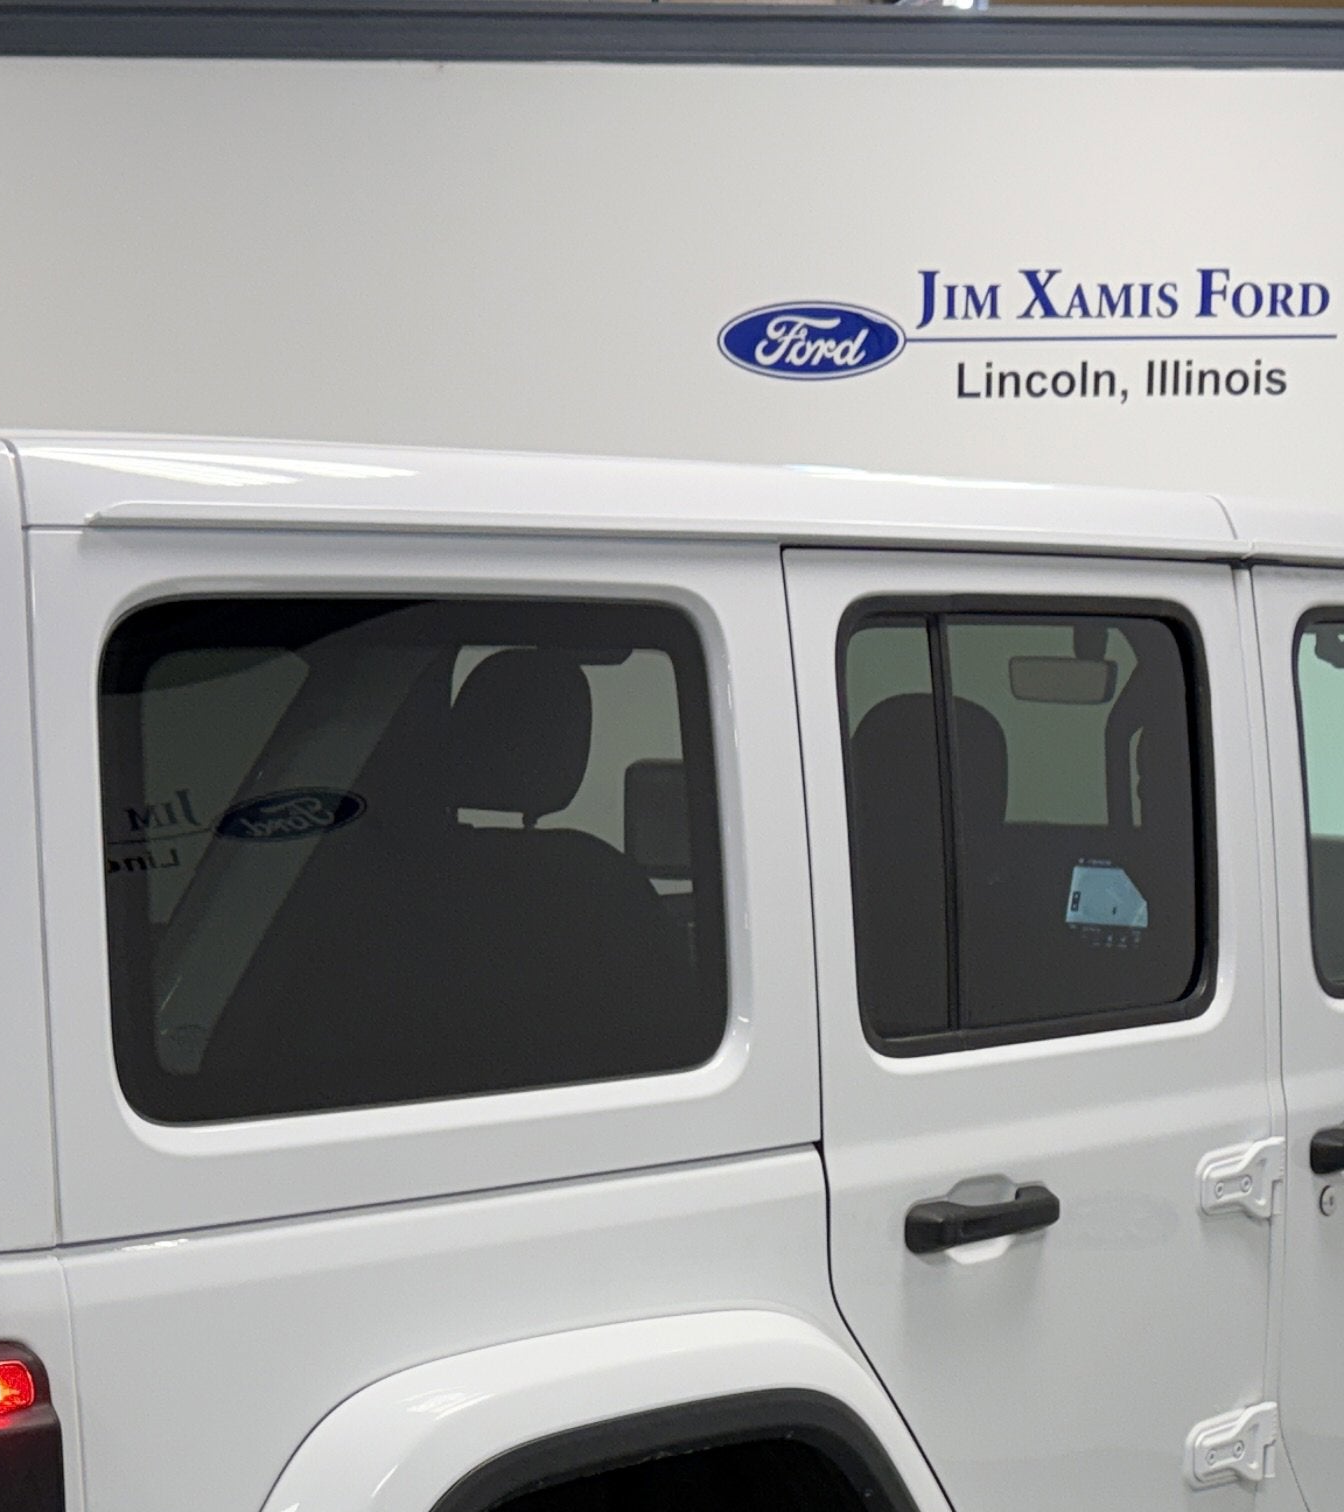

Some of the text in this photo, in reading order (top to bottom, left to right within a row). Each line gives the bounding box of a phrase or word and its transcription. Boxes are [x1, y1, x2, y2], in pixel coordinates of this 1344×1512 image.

[916, 268, 1331, 330] JIM XAMIS FORD
[755, 314, 868, 369] Ford
[957, 359, 1287, 403] Lincoln, Illinois
